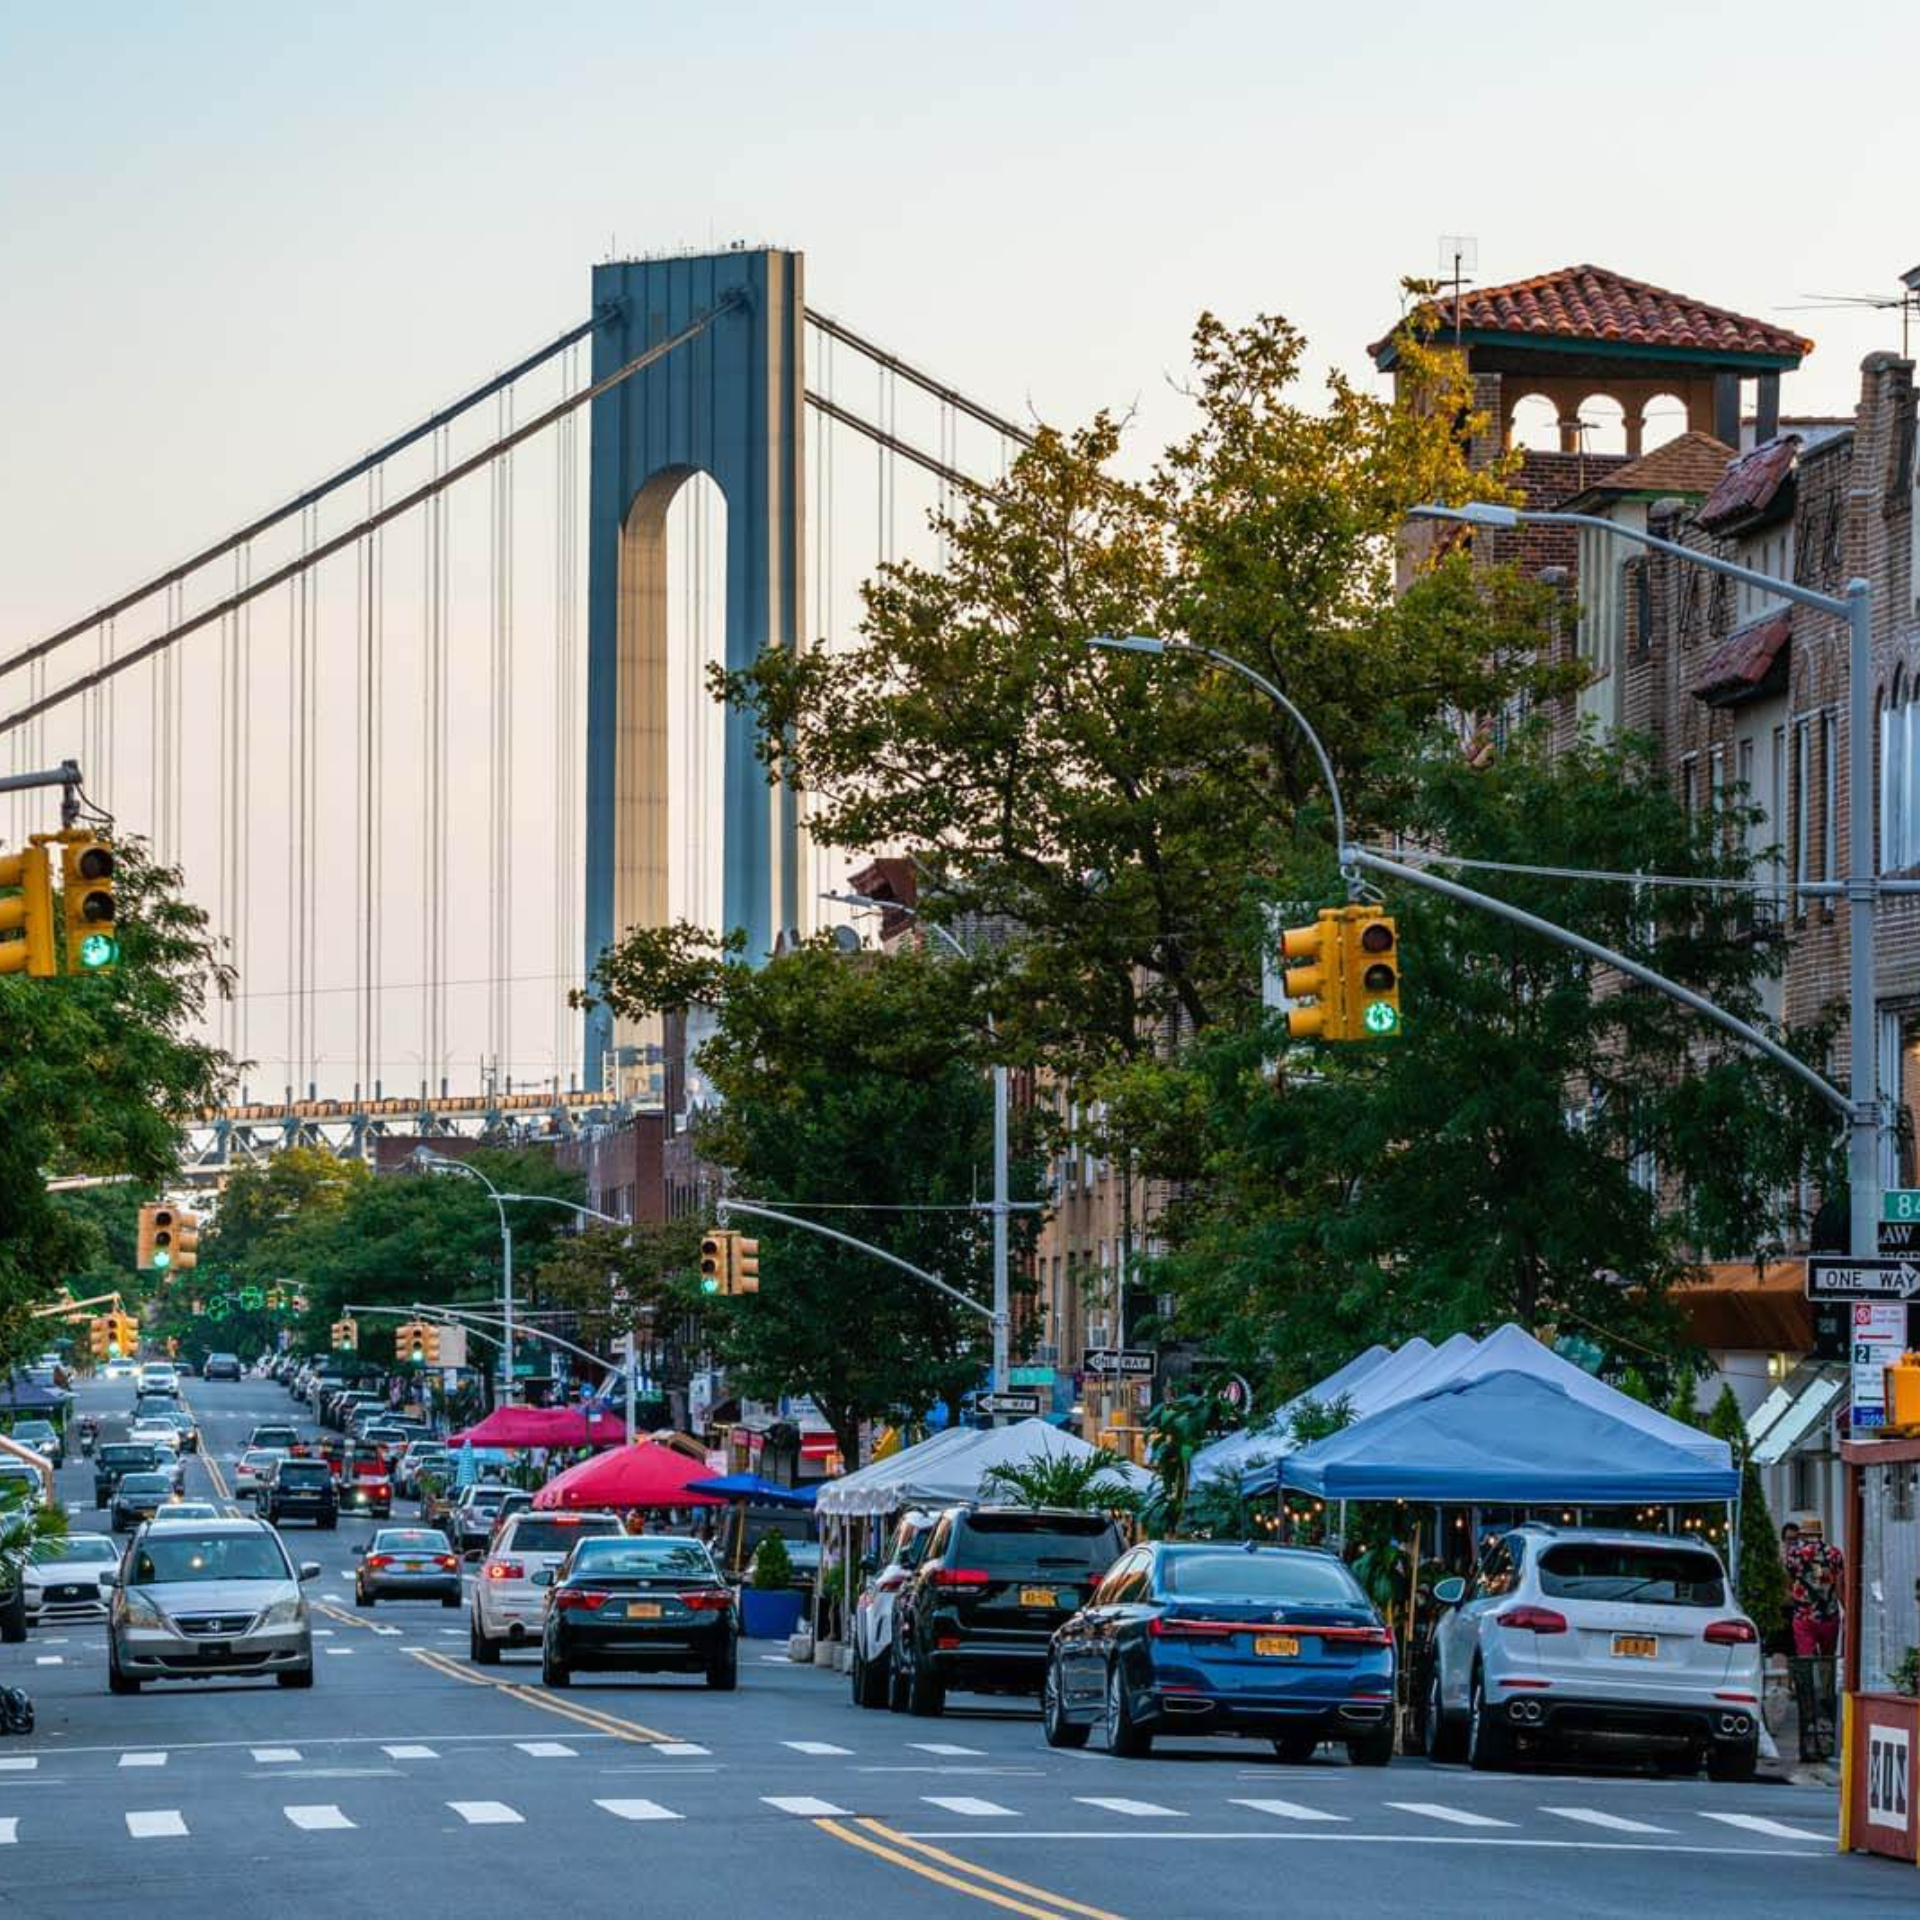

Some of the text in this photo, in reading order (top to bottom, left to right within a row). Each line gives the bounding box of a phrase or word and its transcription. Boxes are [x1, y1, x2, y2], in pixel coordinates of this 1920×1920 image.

[1826, 1271, 1917, 1288] ONE WAY
[1094, 1356, 1145, 1368] ONE WAY
[1857, 1347, 1867, 1363] 2
[1013, 1400, 1033, 1409] WAY
